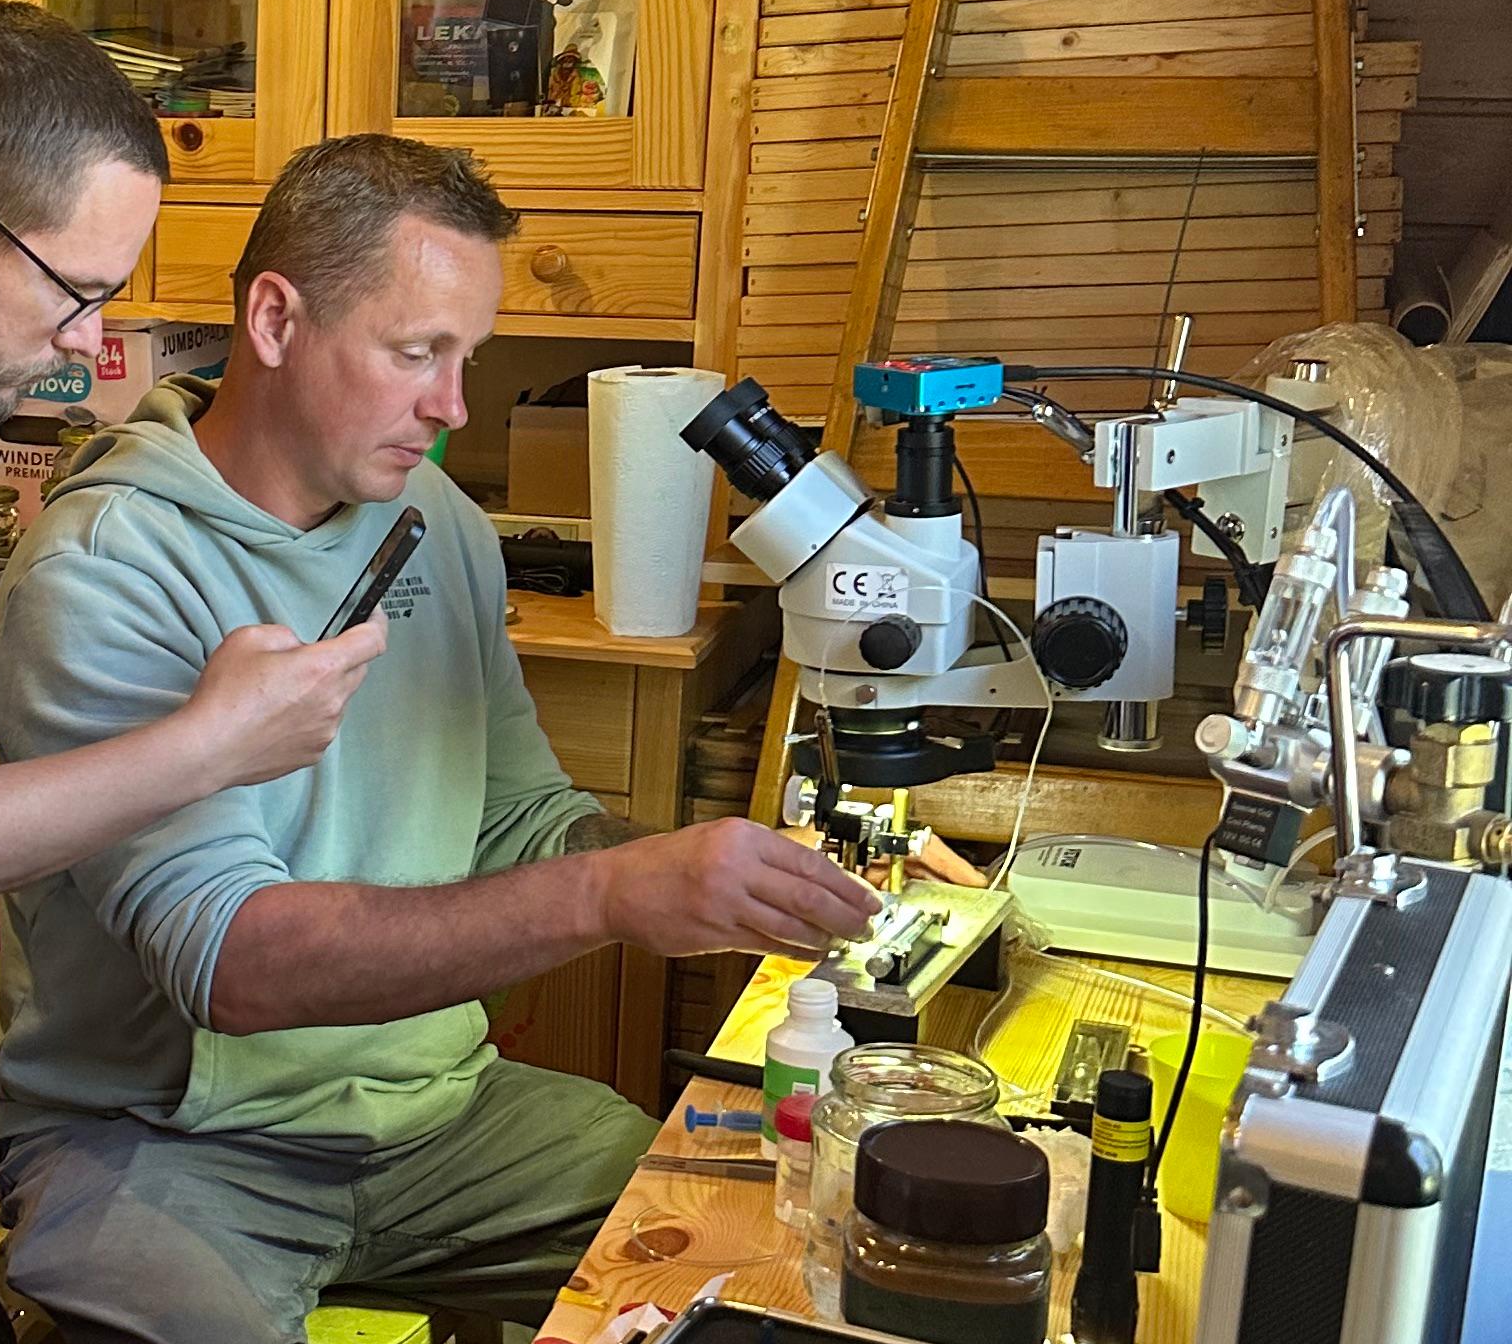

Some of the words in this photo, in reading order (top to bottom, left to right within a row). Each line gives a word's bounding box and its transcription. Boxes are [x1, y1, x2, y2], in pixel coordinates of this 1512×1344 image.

[97, 344, 123, 366] 84
[833, 571, 868, 596] CE
[832, 598, 854, 606] MADE
[872, 601, 899, 609] CHINA
